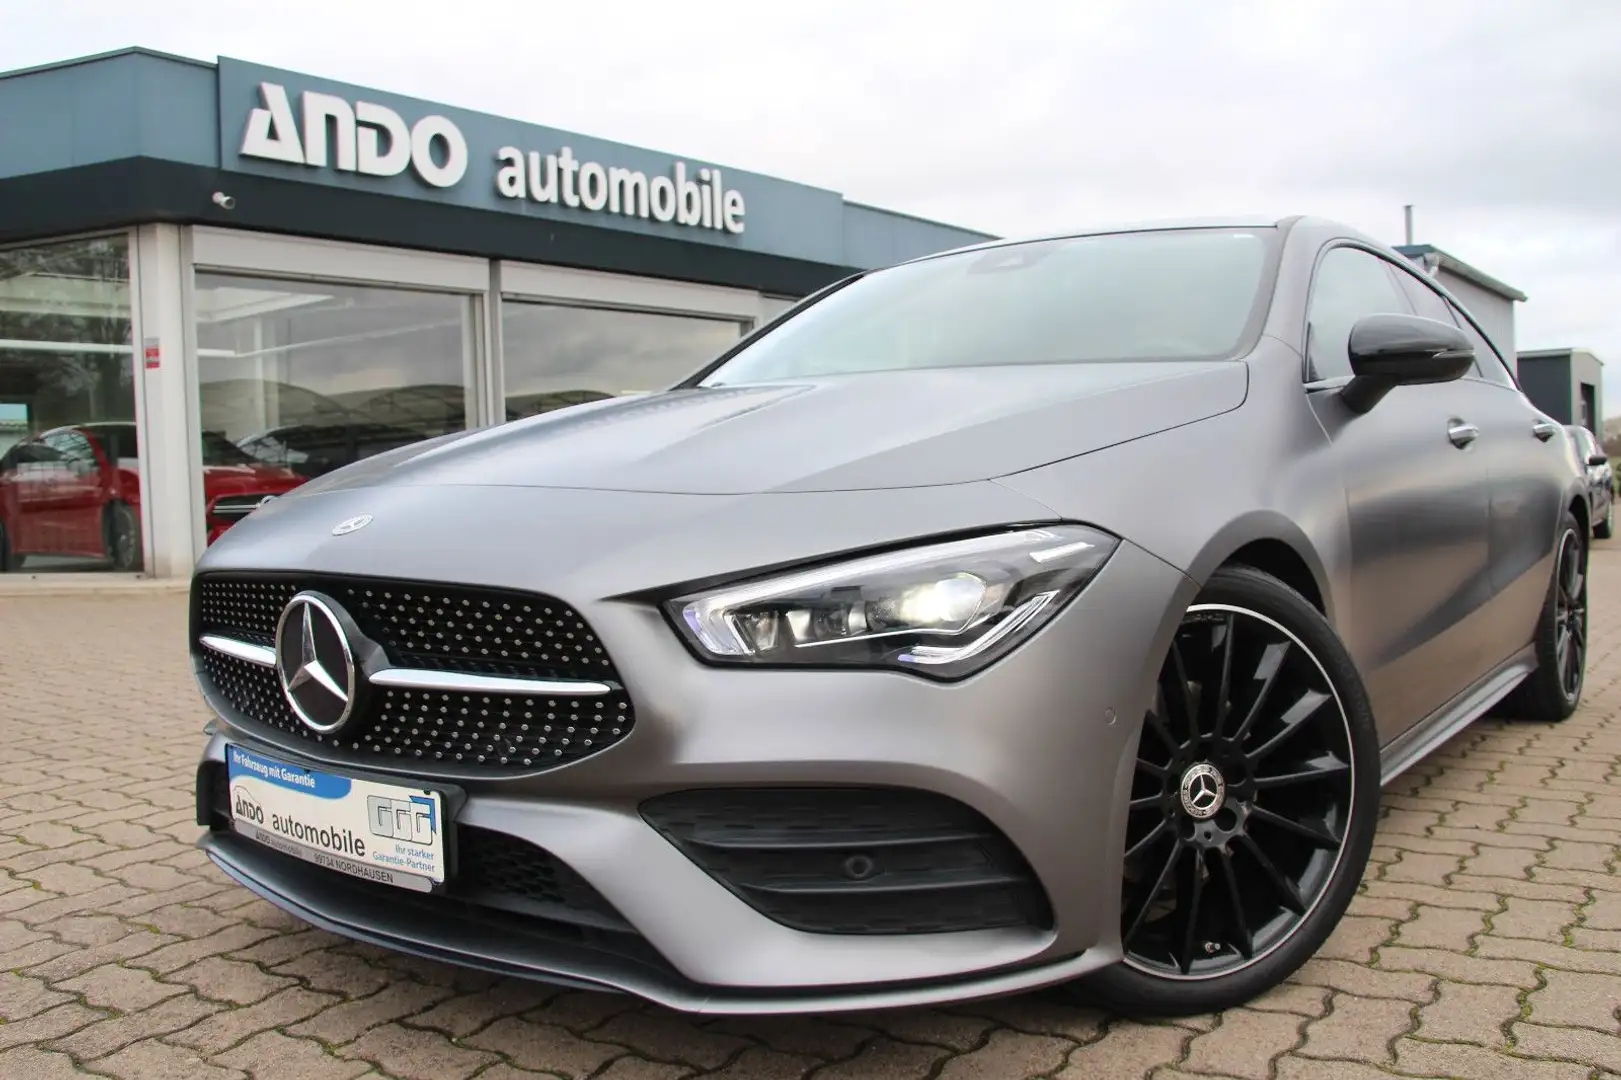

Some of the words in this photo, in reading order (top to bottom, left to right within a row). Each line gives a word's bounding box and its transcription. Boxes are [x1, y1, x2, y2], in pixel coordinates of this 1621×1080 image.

[239, 81, 468, 188] ANDO
[496, 145, 746, 234] automobile
[241, 754, 269, 777] Fahrzeug
[269, 766, 281, 779] mit
[281, 768, 316, 788] Garantie
[236, 795, 264, 824] ANDO
[272, 813, 365, 857] automobile
[372, 851, 436, 873] Garantie-Partner
[395, 843, 406, 854] Ihr
[407, 848, 435, 860] starker
[335, 858, 394, 883] NORDHAUSEN
